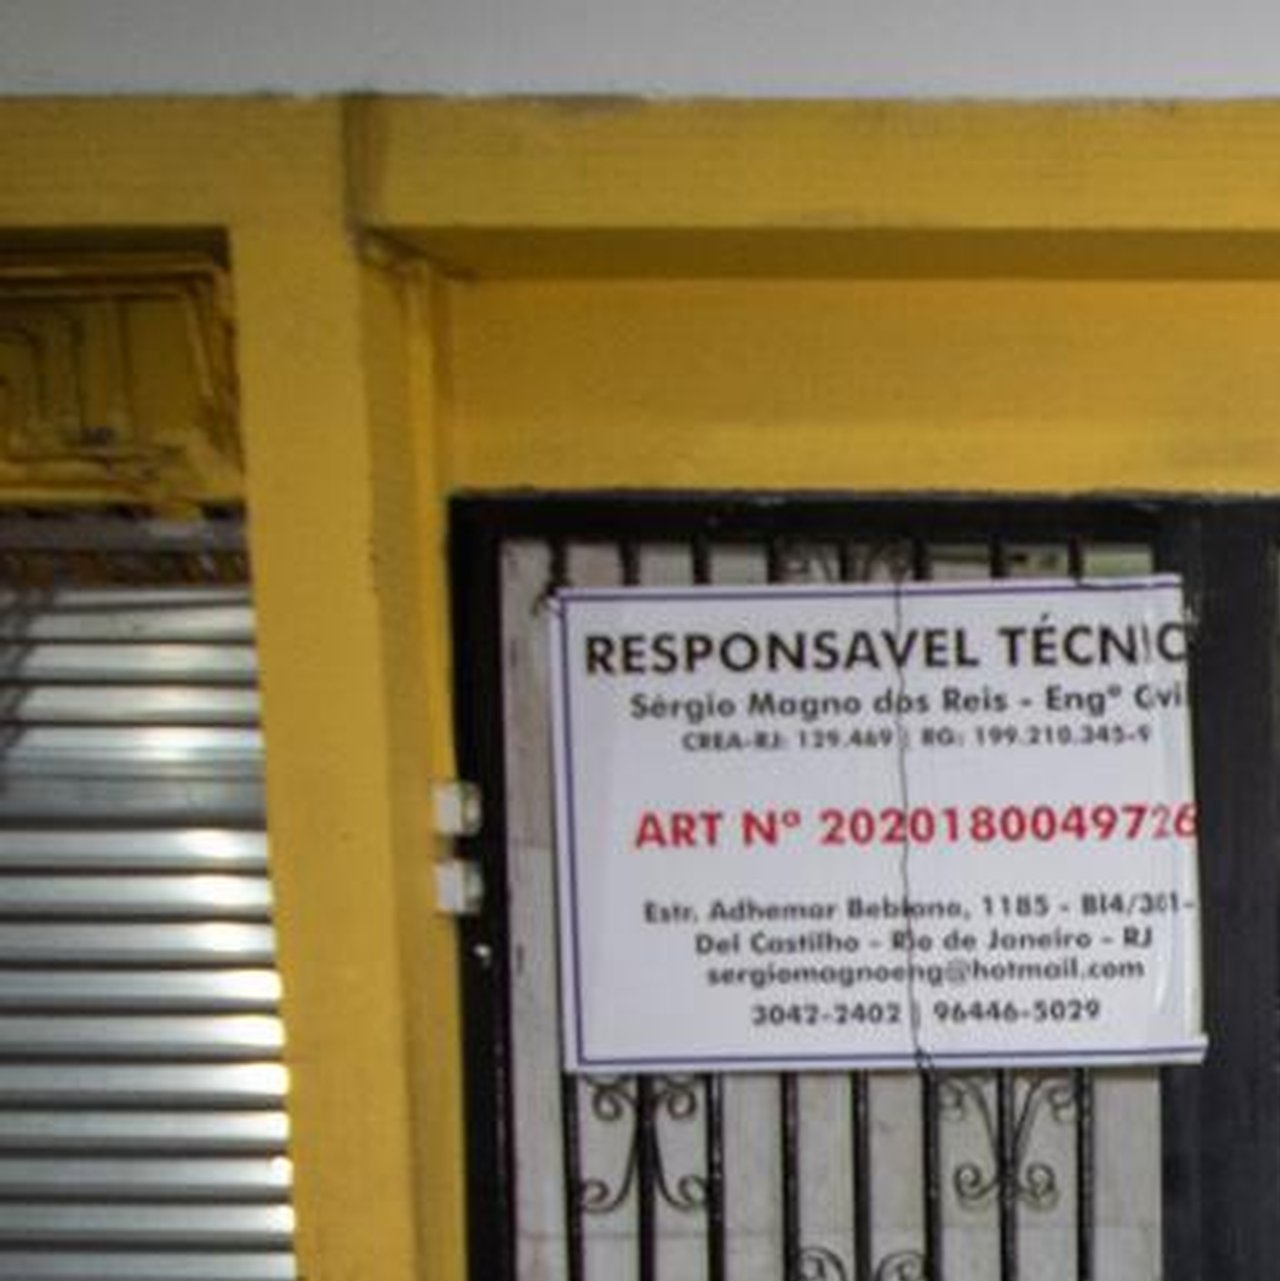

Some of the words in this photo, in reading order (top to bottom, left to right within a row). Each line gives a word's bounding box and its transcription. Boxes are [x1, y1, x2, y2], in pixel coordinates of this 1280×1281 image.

[585, 628, 979, 675] RESPONSAVEL
[748, 690, 862, 722] Magno
[873, 688, 930, 713] dos
[942, 686, 1008, 712] Reis
[635, 811, 723, 849] ART
[982, 895, 1048, 917] 1185
[695, 932, 741, 955] Del
[751, 930, 860, 955] Castilho
[943, 928, 977, 951] de
[987, 926, 1092, 951] Janeiro
[1123, 926, 1153, 949] RJ
